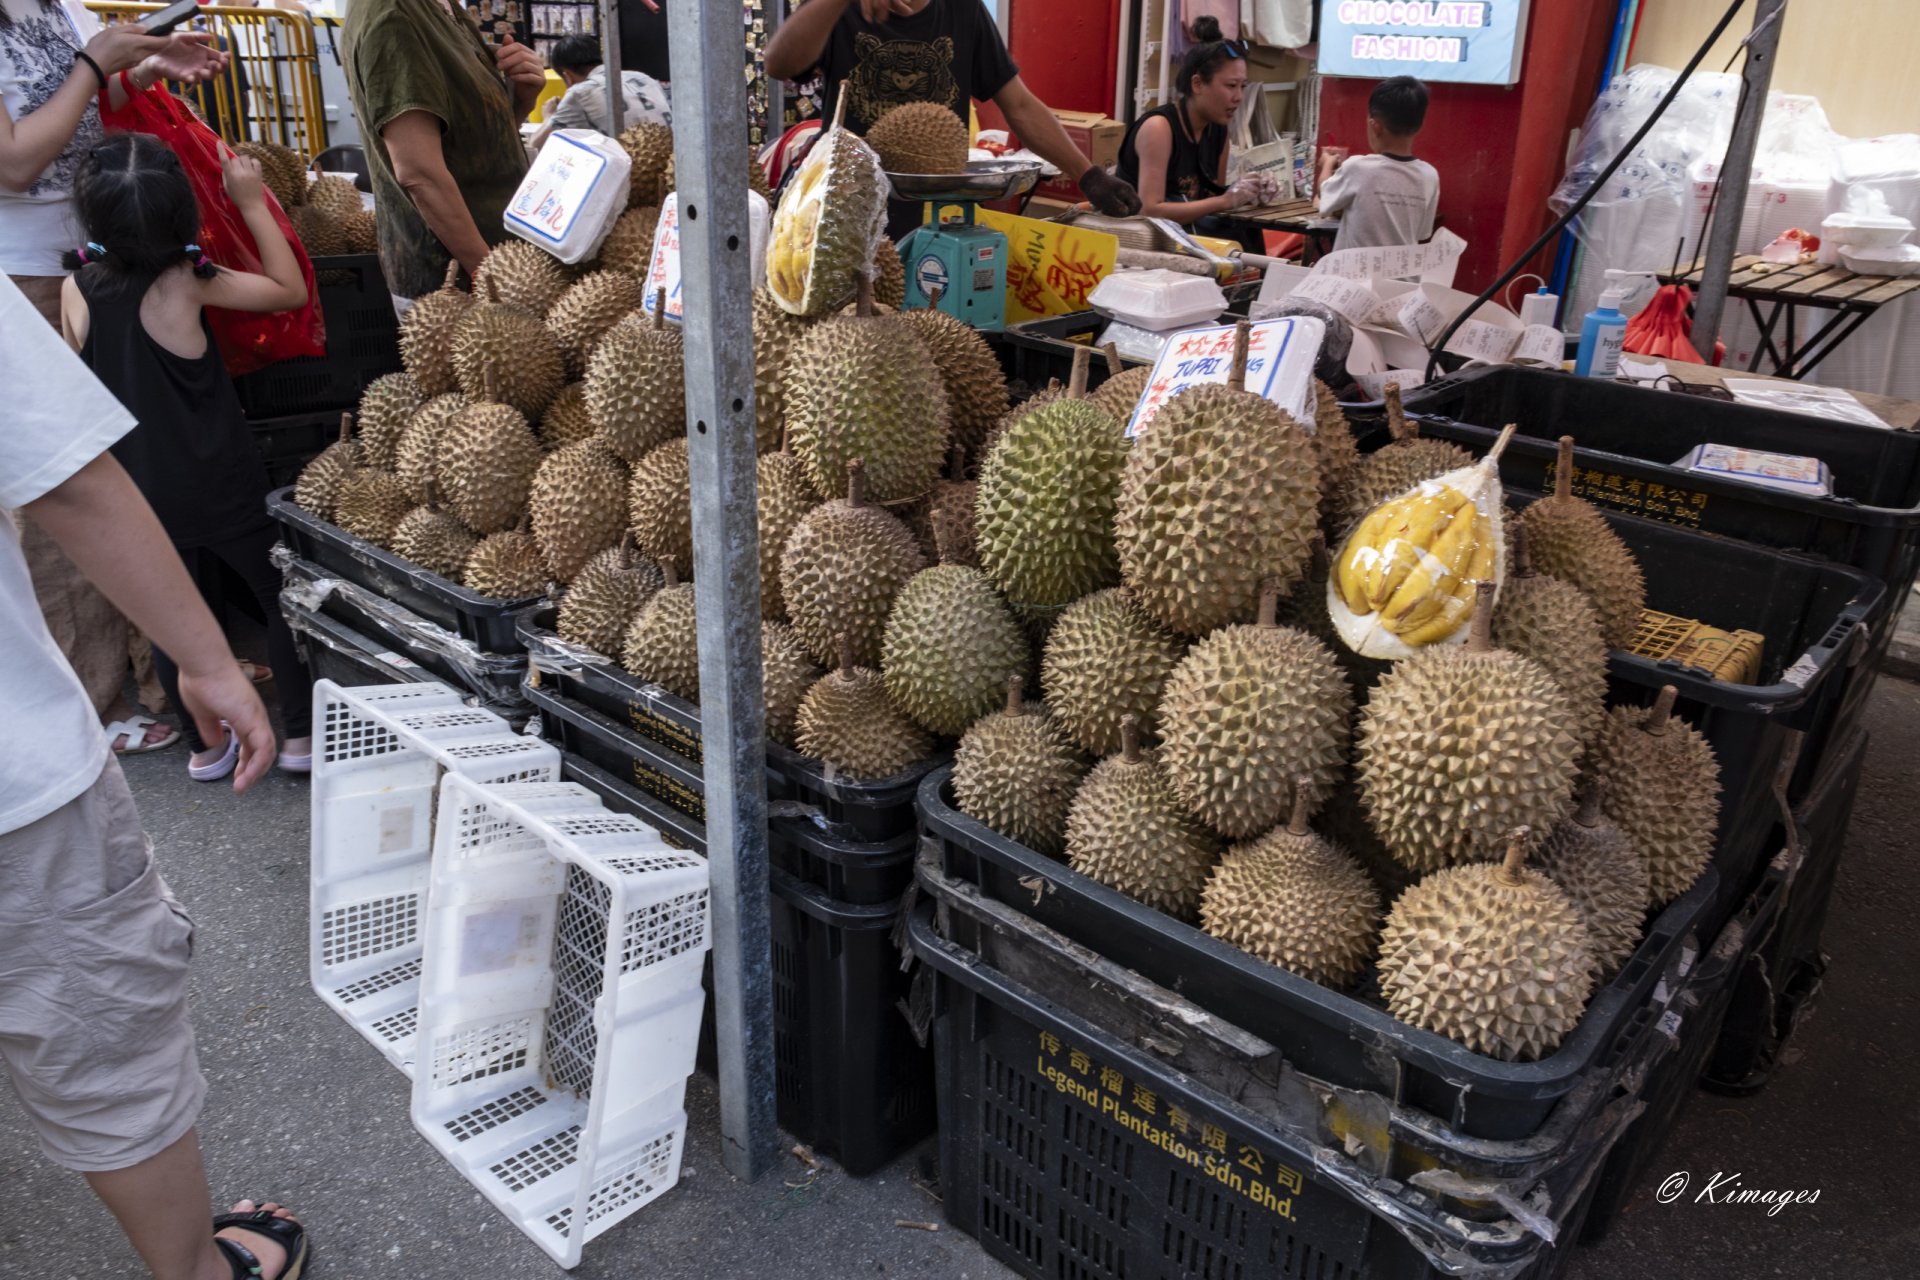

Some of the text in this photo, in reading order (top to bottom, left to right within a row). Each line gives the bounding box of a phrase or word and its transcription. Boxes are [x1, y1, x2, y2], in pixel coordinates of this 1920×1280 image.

[1338, 0, 1484, 26] CHOCOLATE
[1352, 35, 1461, 62] FASHION
[1173, 357, 1224, 379] TUPAI
[1038, 1055, 1099, 1109] Legend
[1102, 1095, 1199, 1168] Plantation
